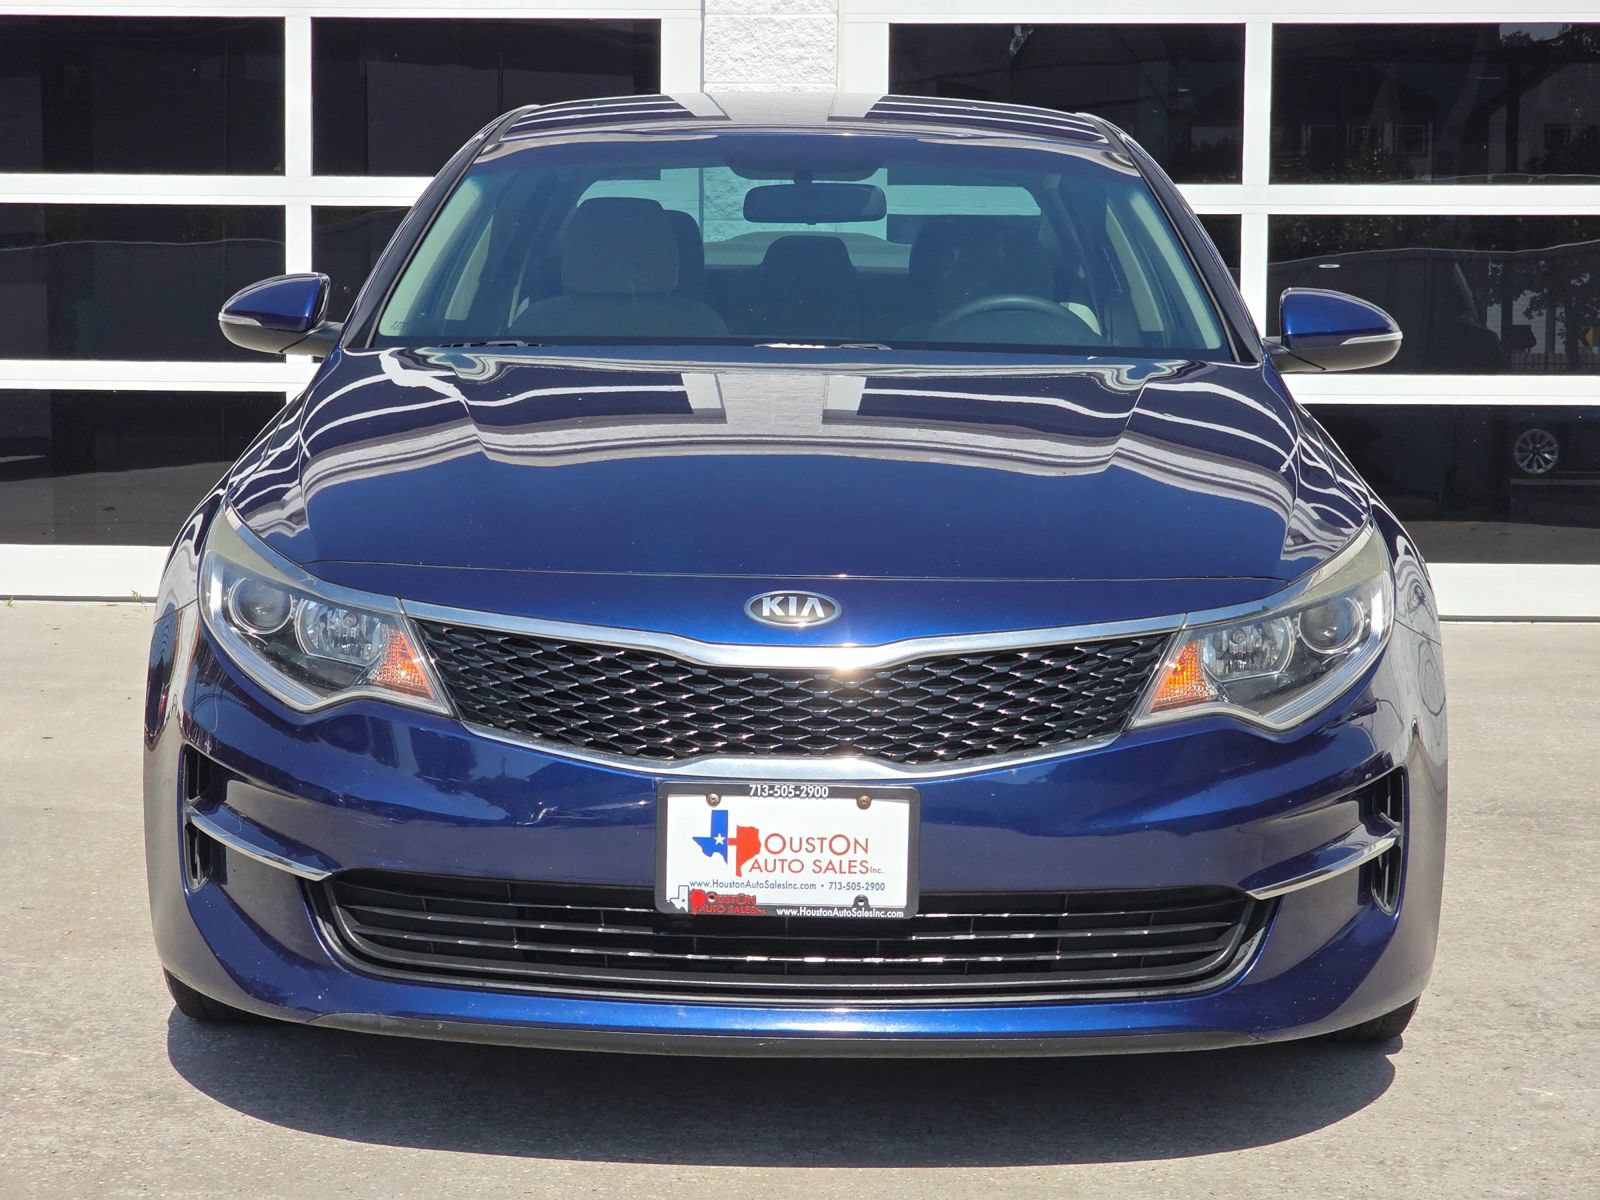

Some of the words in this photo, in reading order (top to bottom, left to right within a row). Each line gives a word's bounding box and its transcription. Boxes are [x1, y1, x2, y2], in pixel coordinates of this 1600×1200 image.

[761, 596, 825, 618] KIA
[748, 784, 830, 798] 713-505-2900
[748, 858, 804, 874] AUTO
[812, 859, 869, 875] SALES
[689, 879, 817, 891] www.HoustonAutoSalesInc.com
[828, 881, 886, 892] 713-505-2900
[699, 905, 725, 914] AUTO
[728, 905, 756, 915] SALES
[776, 906, 904, 919] www.HoustonAutoSalesInc.com
